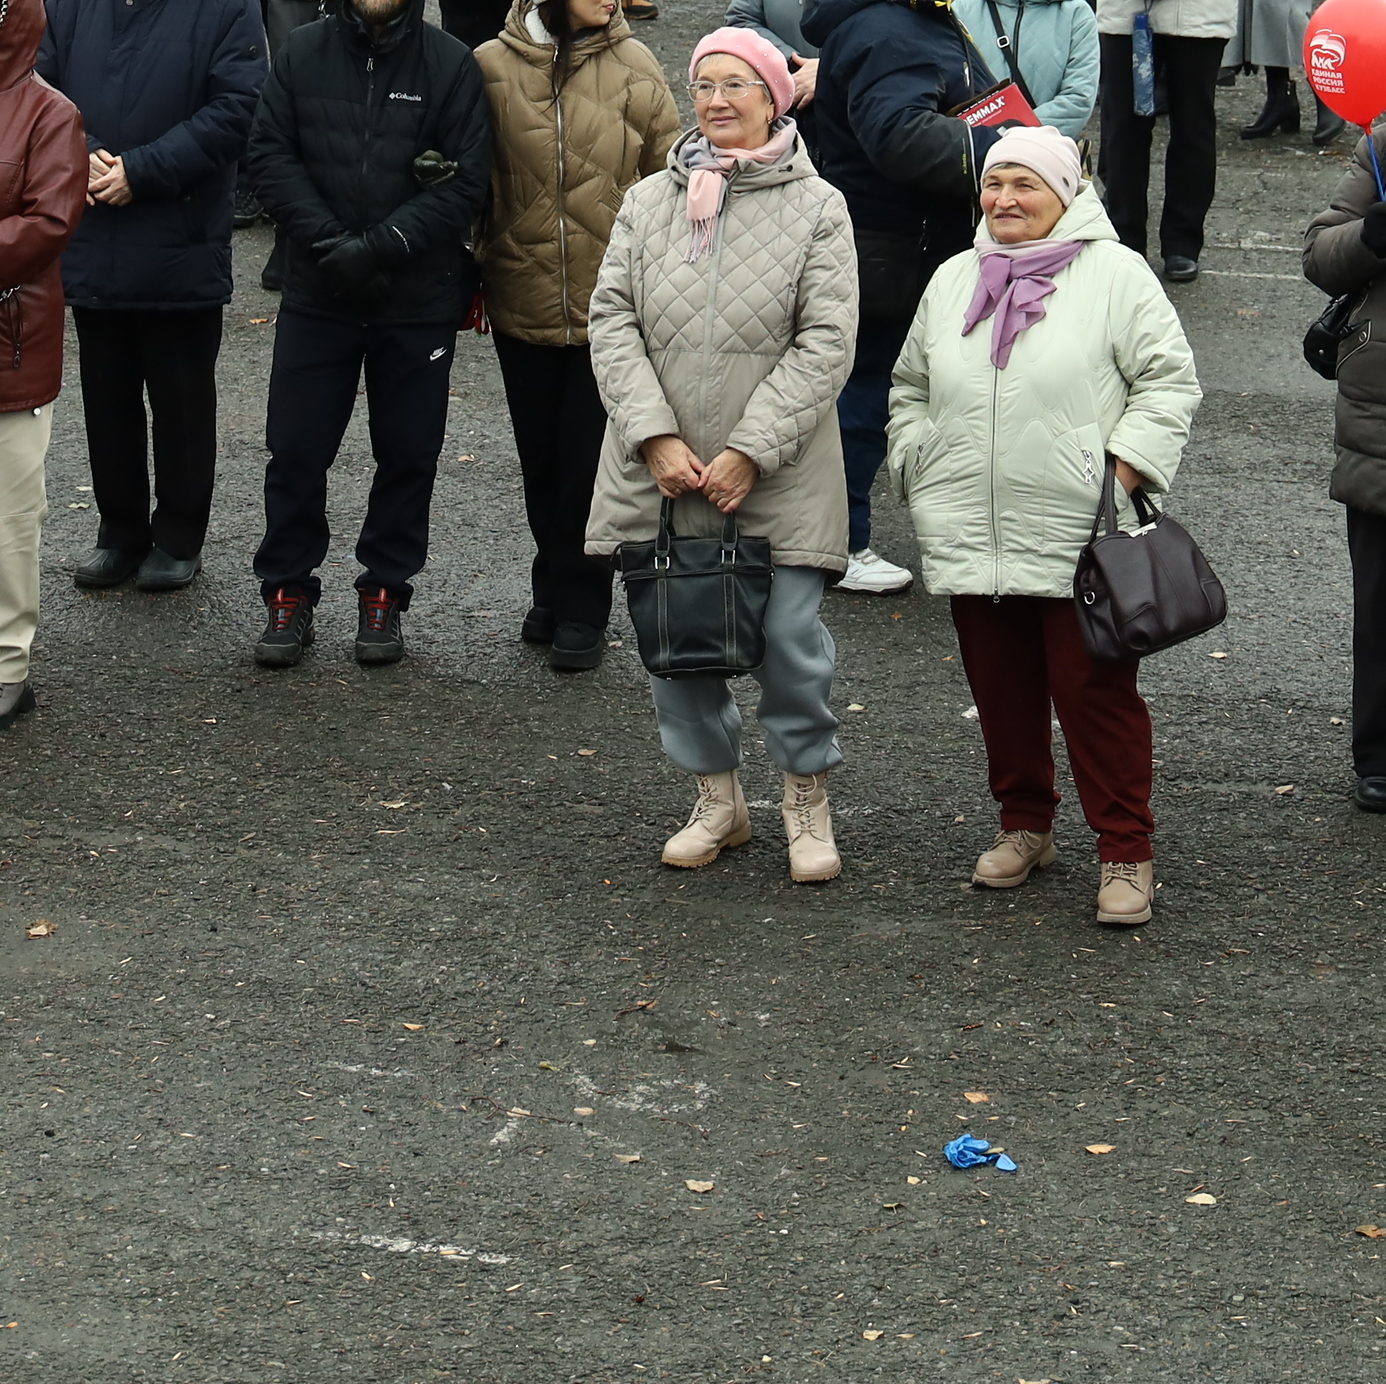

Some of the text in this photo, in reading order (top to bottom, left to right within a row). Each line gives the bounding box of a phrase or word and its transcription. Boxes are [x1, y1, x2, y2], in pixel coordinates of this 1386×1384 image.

[1311, 68, 1343, 79] ЕДИНАЯ
[1313, 76, 1344, 87] РОССИЯ
[1315, 84, 1345, 94] КУЗБАСС
[965, 95, 1006, 126] EMMAX
